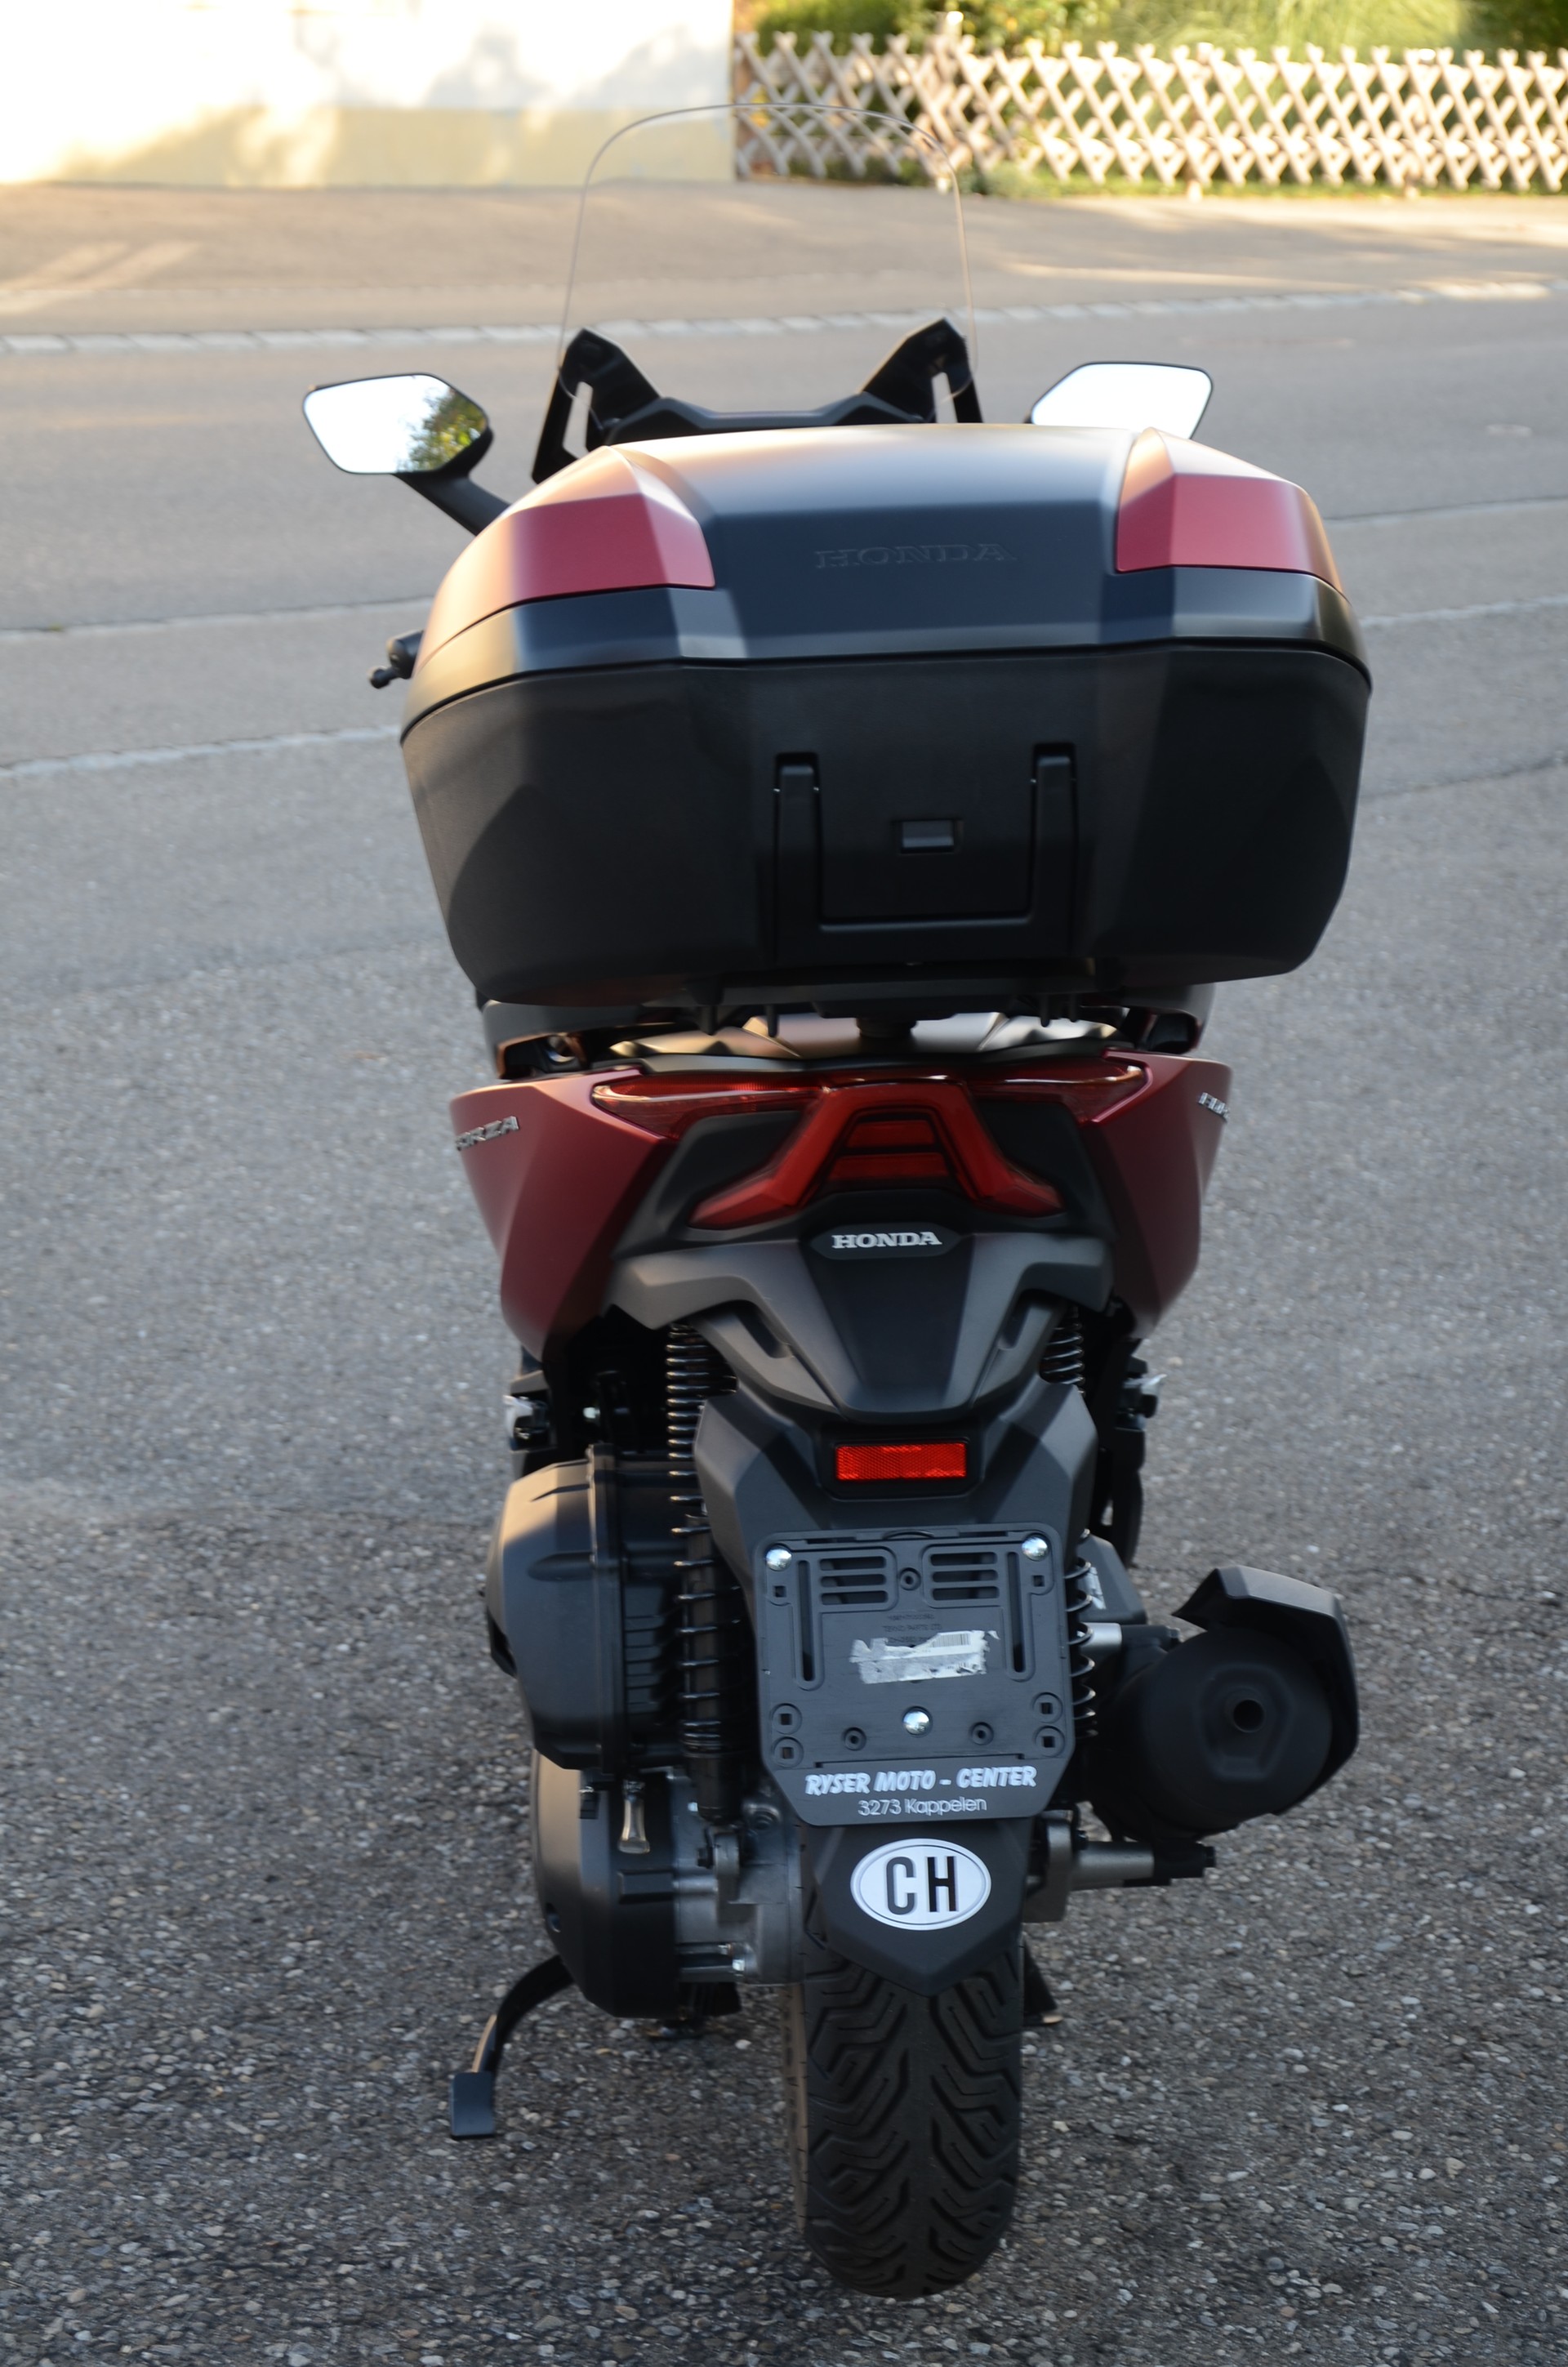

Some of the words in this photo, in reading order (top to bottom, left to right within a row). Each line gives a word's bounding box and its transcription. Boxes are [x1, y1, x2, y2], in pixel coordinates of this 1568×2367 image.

[814, 543, 1018, 569] HONDA
[831, 1231, 942, 1249] HONDA
[804, 1772, 871, 1796] RYSER
[873, 1770, 937, 1792] MOTO
[956, 1766, 1037, 1788] CENTER
[858, 1799, 902, 1816] 3273
[904, 1797, 987, 1816] Kappelen
[886, 1856, 957, 1915] CH
